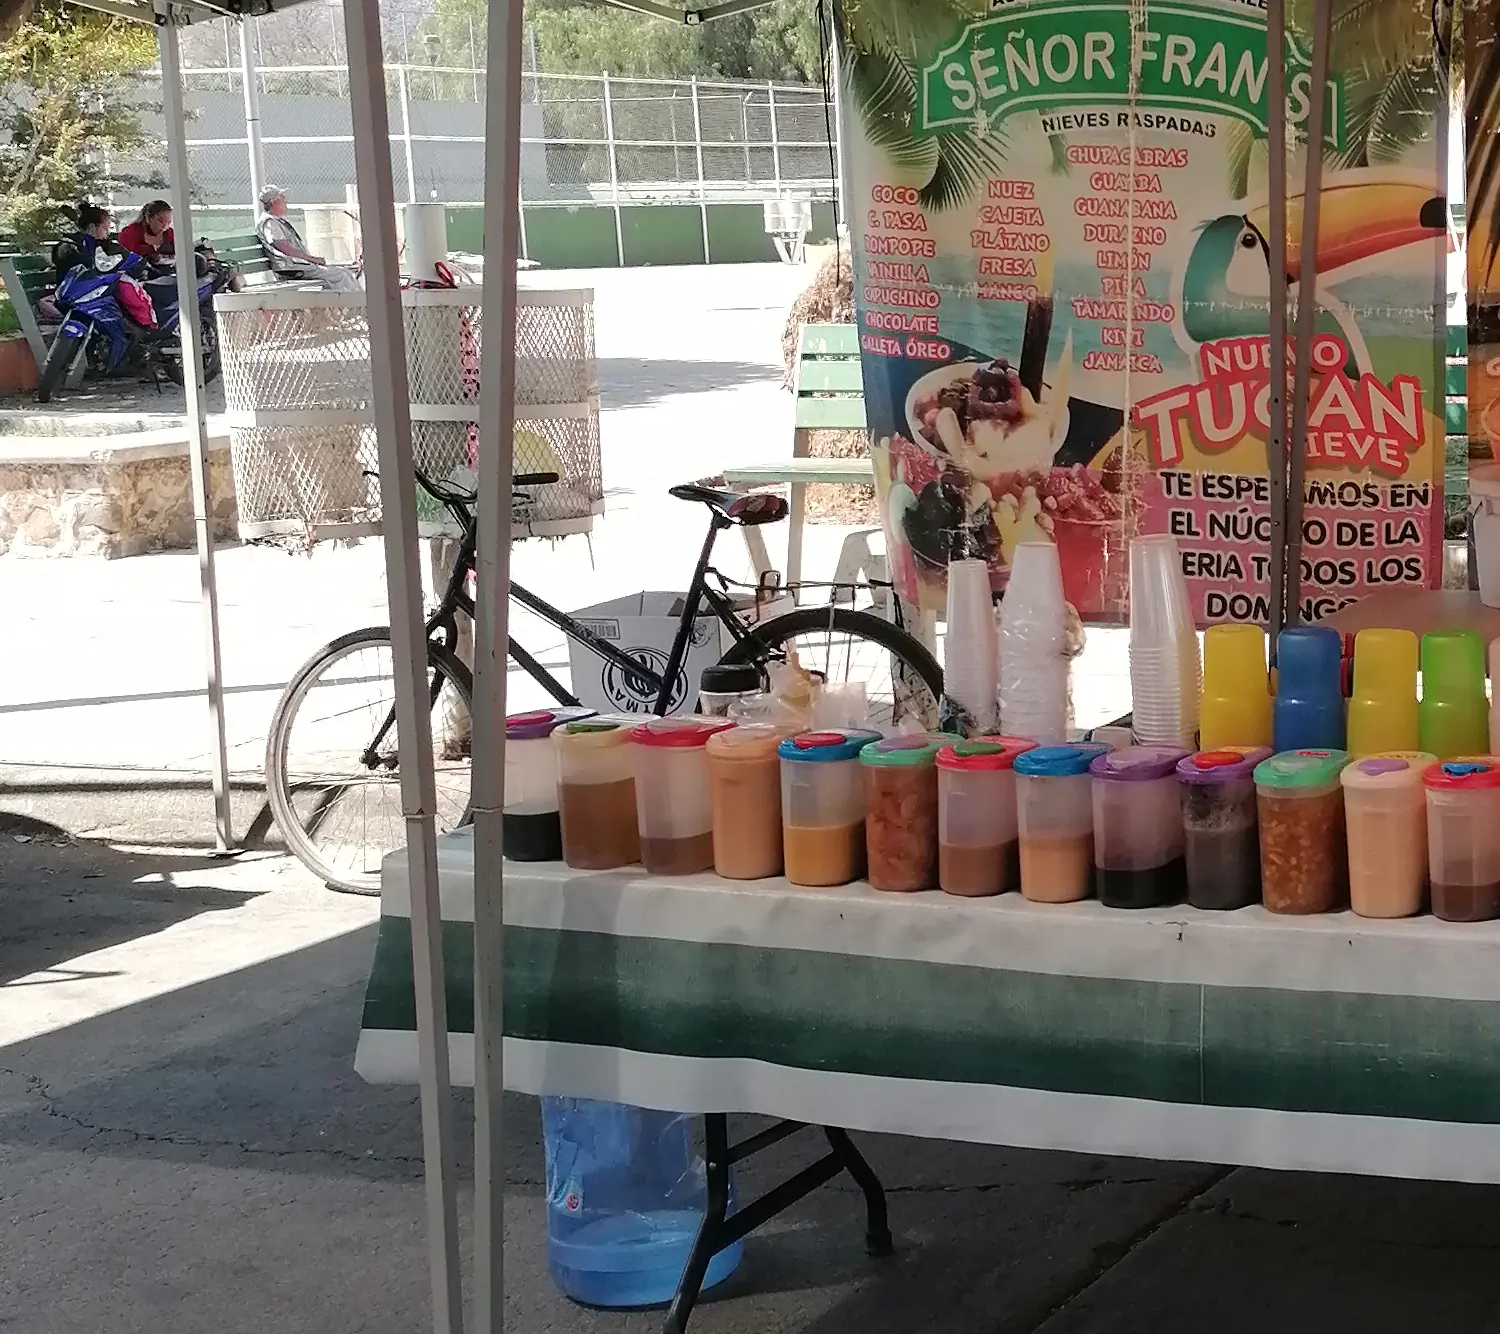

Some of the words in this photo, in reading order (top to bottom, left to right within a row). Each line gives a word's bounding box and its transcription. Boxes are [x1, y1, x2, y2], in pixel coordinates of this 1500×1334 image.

[943, 28, 1116, 111] SEÑOR
[1041, 112, 1110, 134] NIEVES
[872, 185, 920, 204] COCO
[989, 180, 1035, 199] NUEZ
[883, 210, 928, 231] PASA
[980, 205, 1045, 226] CAJETA
[970, 228, 1051, 252] PLÁTANO
[980, 256, 1038, 277] FRESA
[865, 309, 940, 335] CHOCOLATE
[904, 336, 951, 360] ÓREO
[1161, 471, 1192, 497] TE
[1390, 483, 1430, 508] EN
[1171, 510, 1200, 537] EL
[1336, 521, 1375, 547] DE
[1385, 520, 1421, 545] LA
[1180, 550, 1243, 579] ERIA
[1366, 557, 1422, 584] LOS
